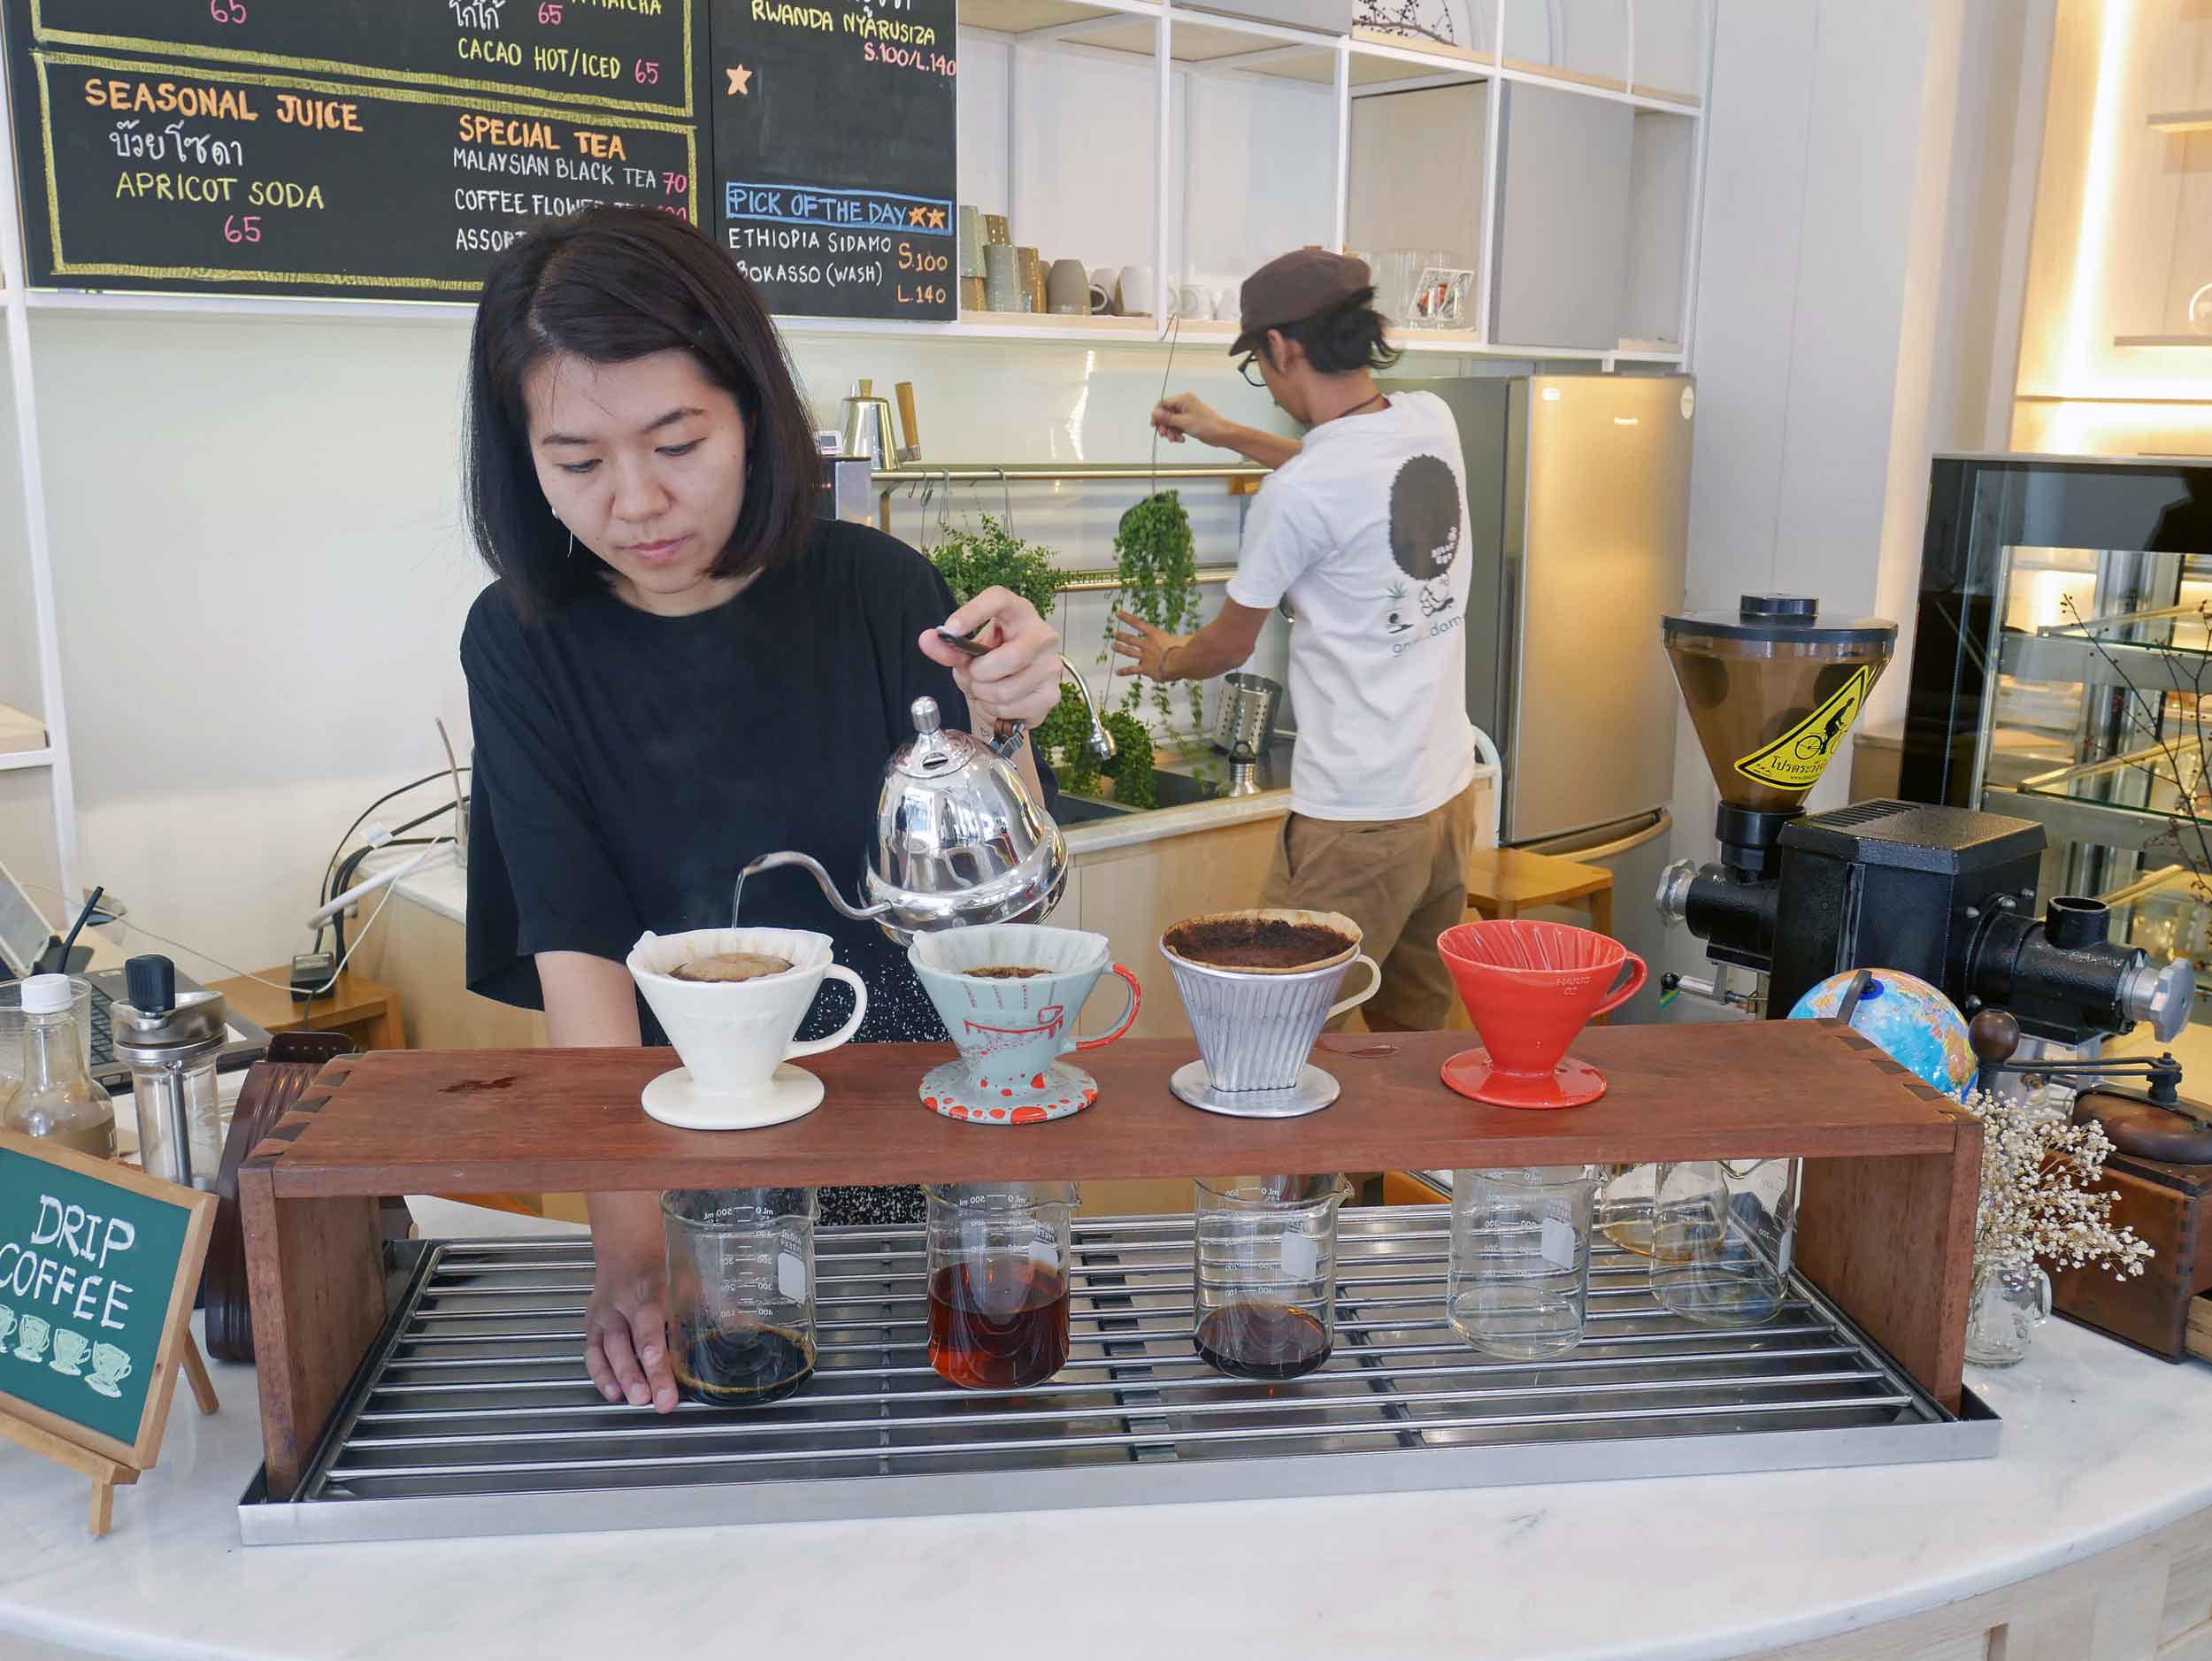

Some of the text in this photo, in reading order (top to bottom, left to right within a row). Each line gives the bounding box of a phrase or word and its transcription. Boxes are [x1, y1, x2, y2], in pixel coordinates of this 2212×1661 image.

[211, 0, 247, 25] 65
[537, 2, 565, 25] 65
[750, 0, 834, 32] RWANDA
[842, 12, 936, 46] NYARUSIZA
[457, 37, 659, 84] CACAO HOT/ICED 65
[84, 78, 365, 133] SEASONAL JUICE
[458, 114, 627, 161] SPECIAL TEA
[115, 170, 326, 210] APRICOT SODA
[453, 147, 688, 195] MALAYSIAN BLACK TEA 70
[455, 188, 529, 214] COFFEE
[728, 188, 908, 230] PICK OF THE DAY
[223, 215, 263, 243] 65
[728, 227, 892, 254] ETHIOPIA SIDAMO
[826, 261, 884, 288] (WASH)
[30, 1194, 135, 1270] DRIP
[0, 1242, 134, 1330] COFFEE
